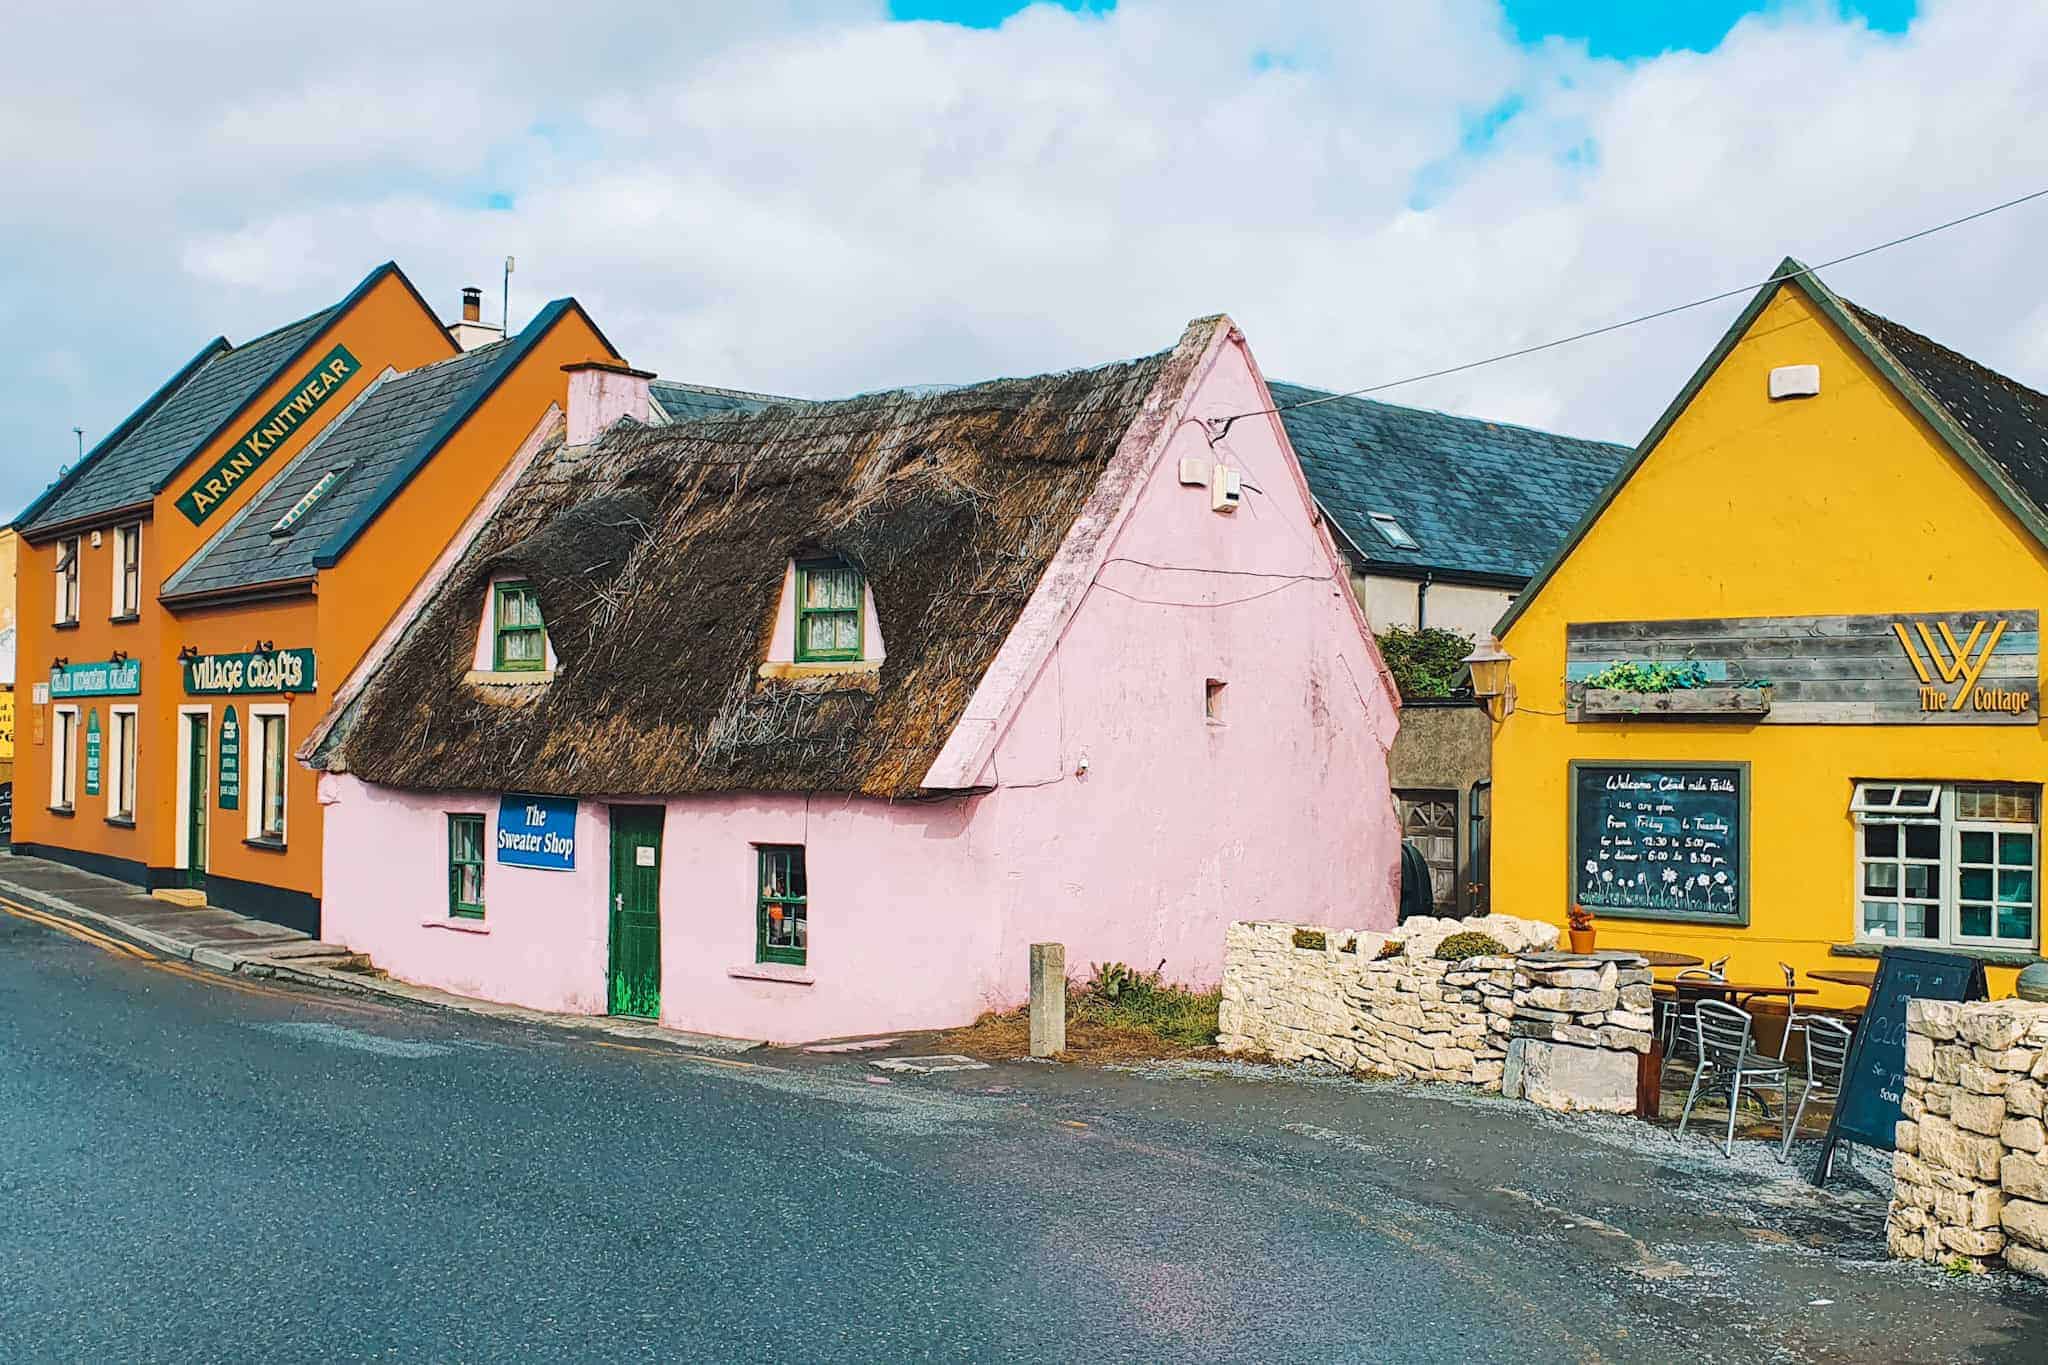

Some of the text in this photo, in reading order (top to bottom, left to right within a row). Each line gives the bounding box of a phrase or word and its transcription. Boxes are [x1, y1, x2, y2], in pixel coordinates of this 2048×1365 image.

[192, 358, 349, 515] ARAN KNITWEAR
[1920, 686, 2031, 714] The Cottage
[525, 804, 546, 826] The
[1638, 802, 1652, 811] are
[1694, 817, 1729, 834] Tuesday
[498, 828, 573, 861] Sweater Shop
[1642, 837, 1668, 847] 12:30
[1647, 850, 1668, 861] 6:00
